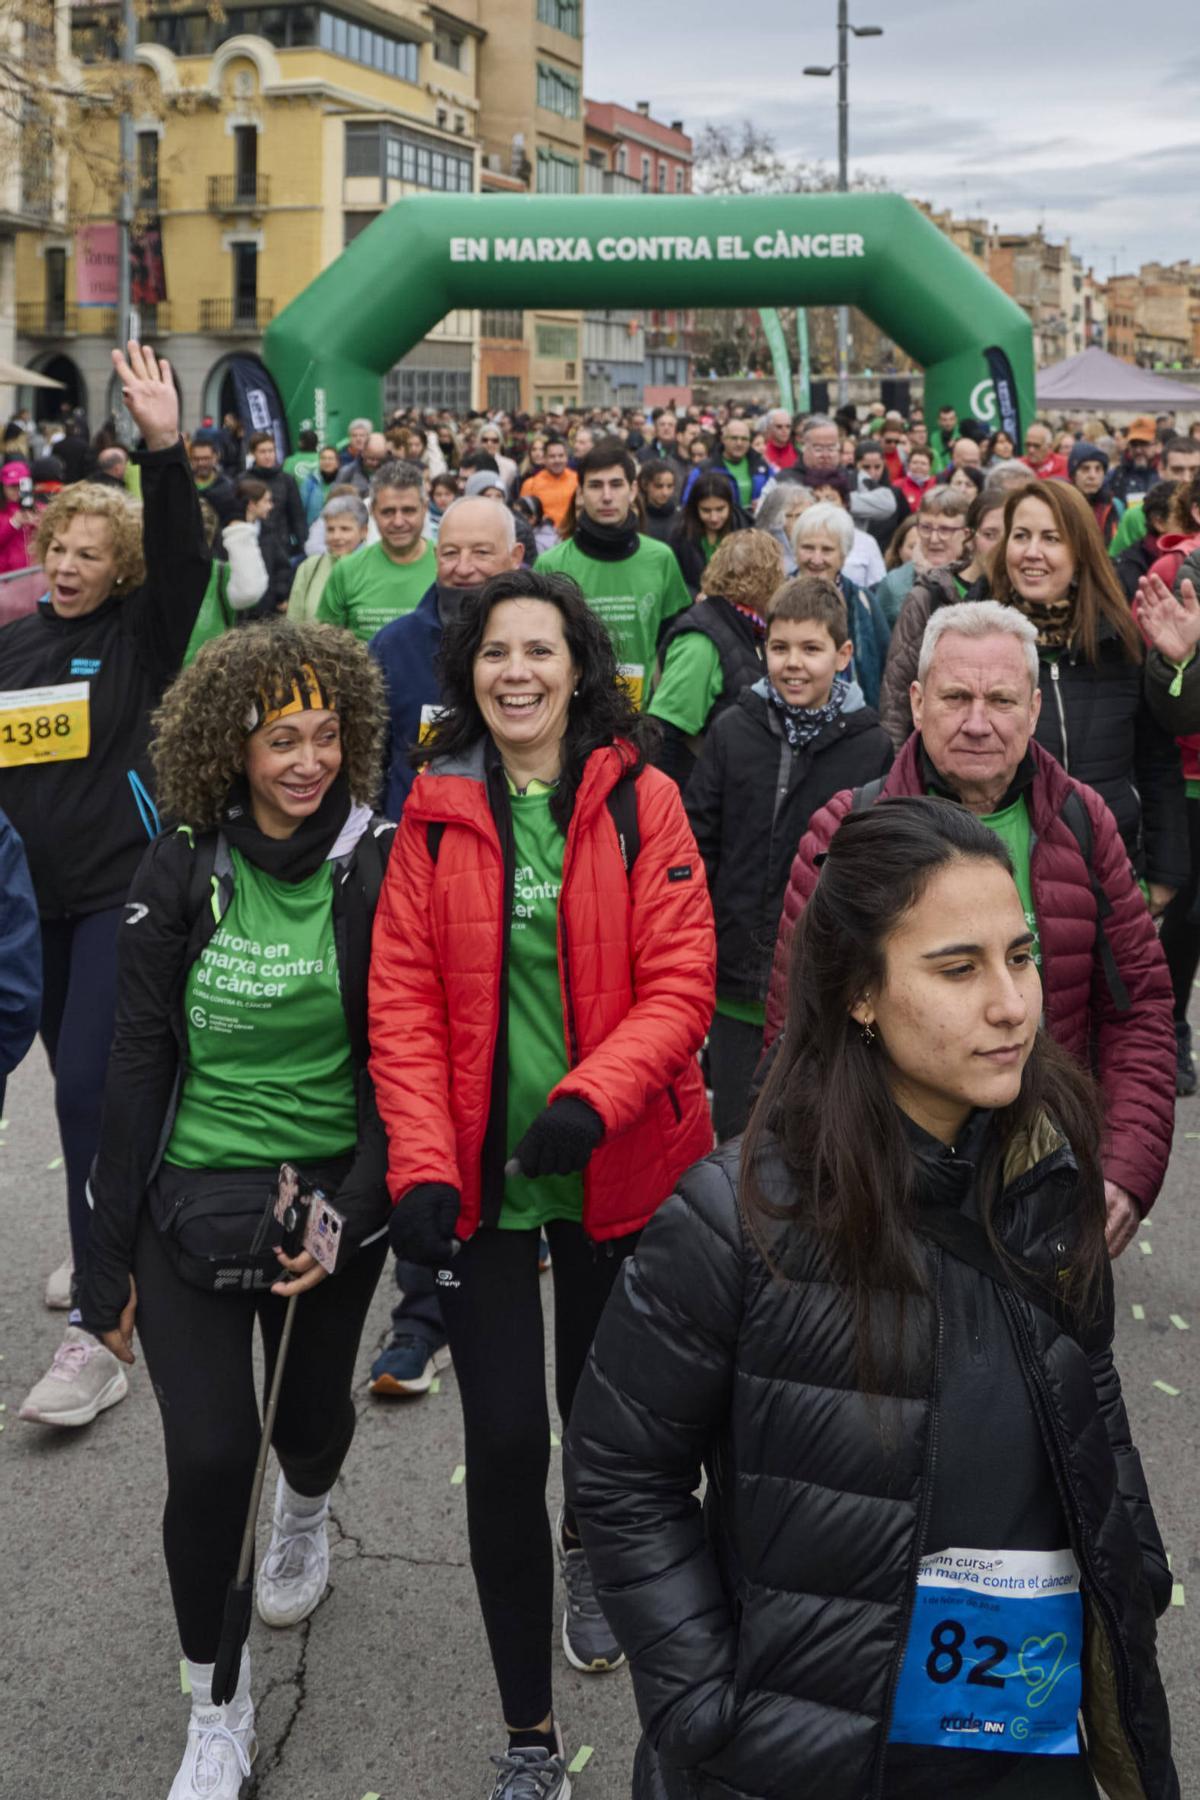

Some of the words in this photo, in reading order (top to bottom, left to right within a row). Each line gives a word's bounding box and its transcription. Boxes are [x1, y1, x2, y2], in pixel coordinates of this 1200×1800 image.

[450, 237, 488, 262] EN
[494, 237, 593, 262] MARXA
[597, 236, 713, 263] CONTRA
[717, 235, 750, 260] EL
[753, 229, 865, 259] CÀNCER
[2, 713, 71, 746] 1388
[514, 866, 534, 881] en
[514, 881, 562, 900] contr
[512, 904, 535, 919] er
[263, 943, 290, 959] en
[200, 948, 257, 976] marxa
[259, 957, 324, 978] contra
[196, 966, 212, 986] el
[215, 973, 287, 998] càncer
[956, 1557, 994, 1571] cursa
[936, 1568, 979, 1583] marxa
[982, 1576, 1025, 1590] contra
[1028, 1576, 1039, 1588] el
[1041, 1573, 1074, 1588] càncer
[926, 1619, 1008, 1689] 82
[984, 1721, 1005, 1733] INN
